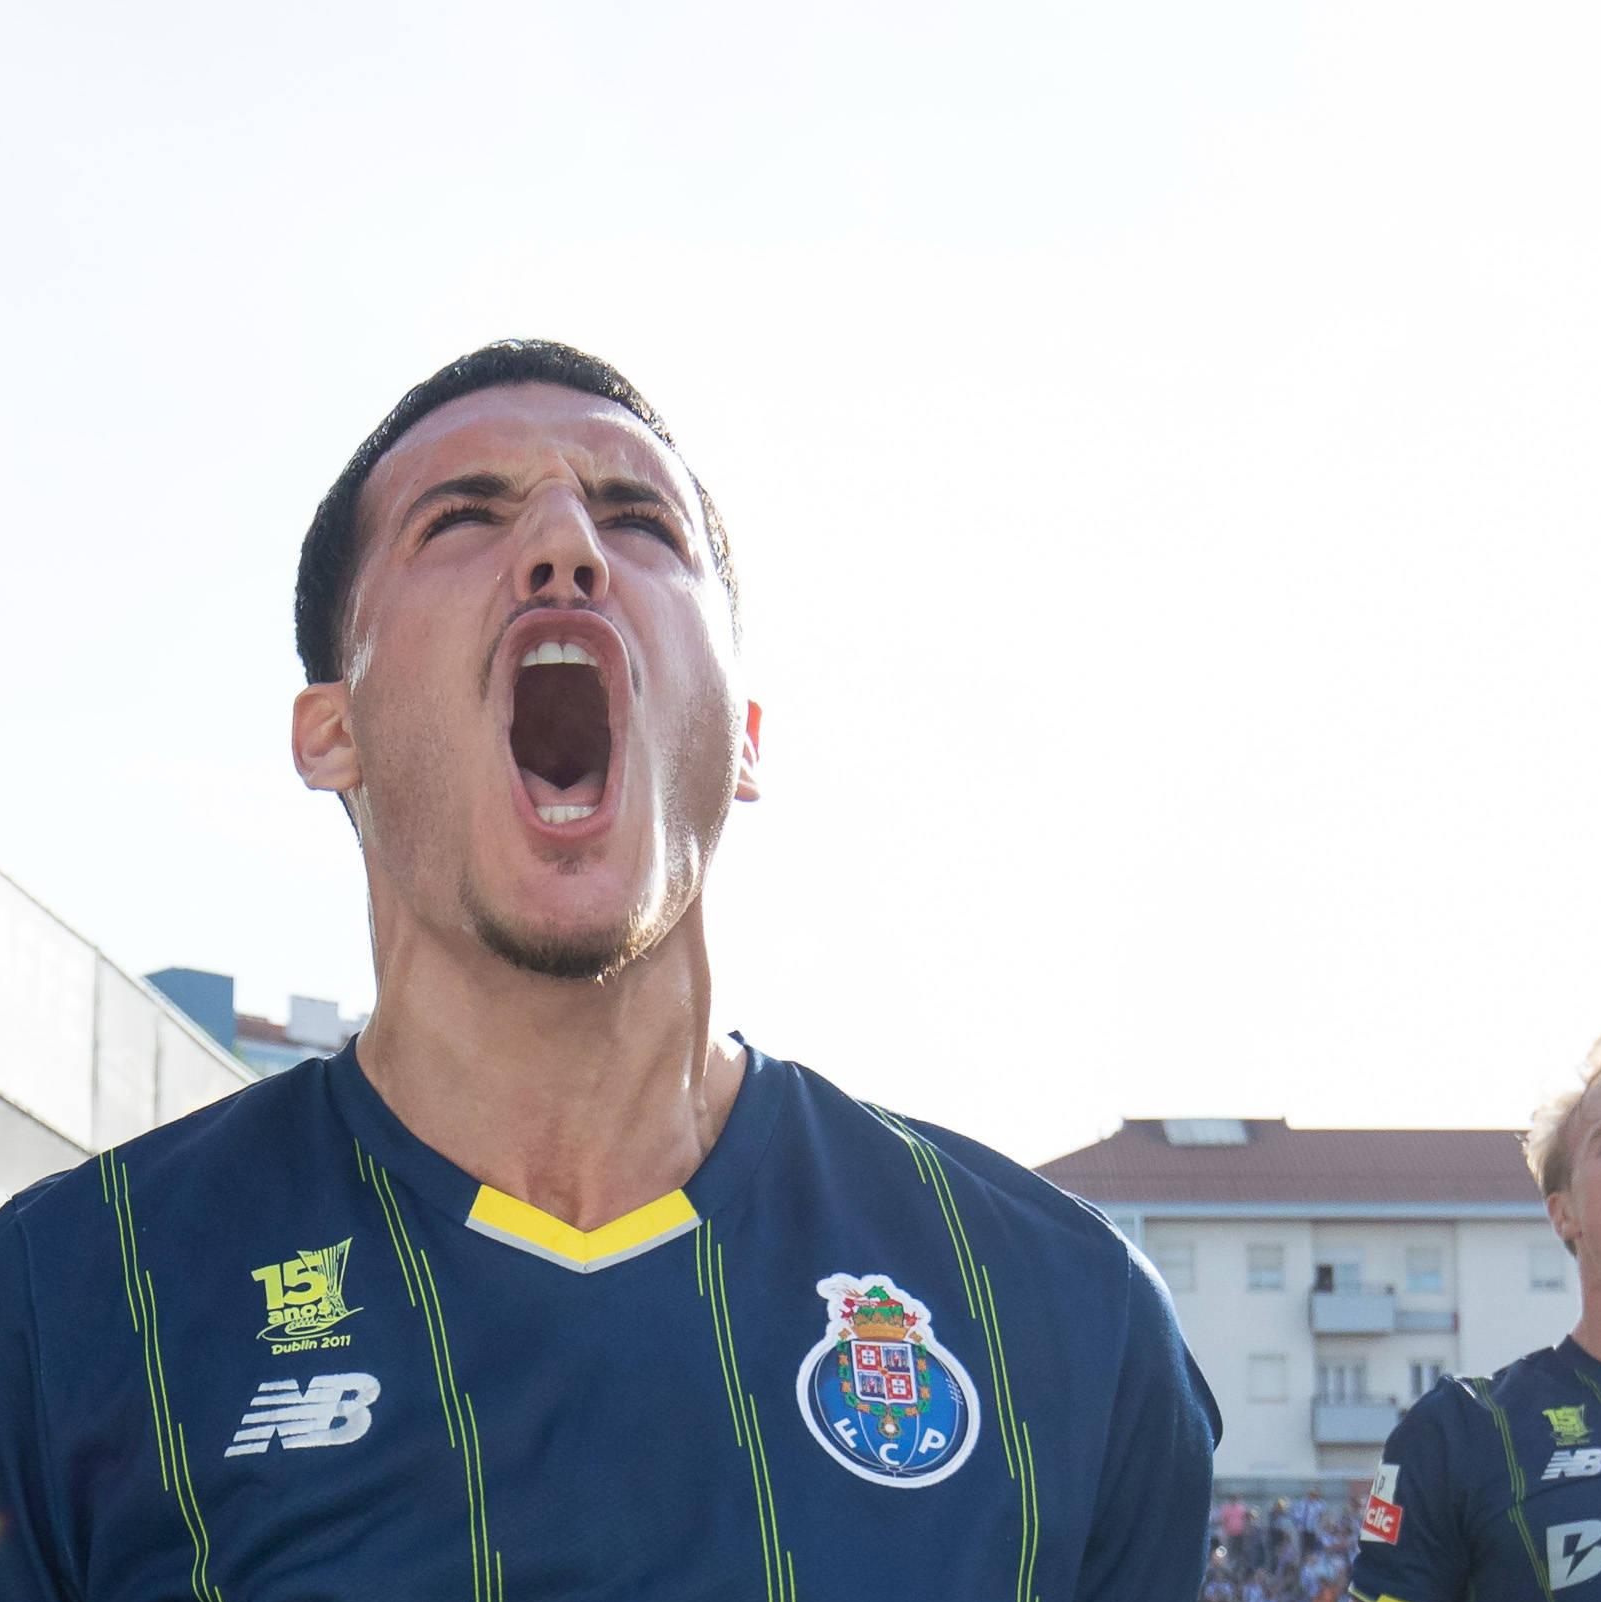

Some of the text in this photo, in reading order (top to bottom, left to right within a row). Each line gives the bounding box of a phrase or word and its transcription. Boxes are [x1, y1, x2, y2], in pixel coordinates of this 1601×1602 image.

[251, 1255, 328, 1310] 15
[271, 1334, 351, 1355] Dublin 2011
